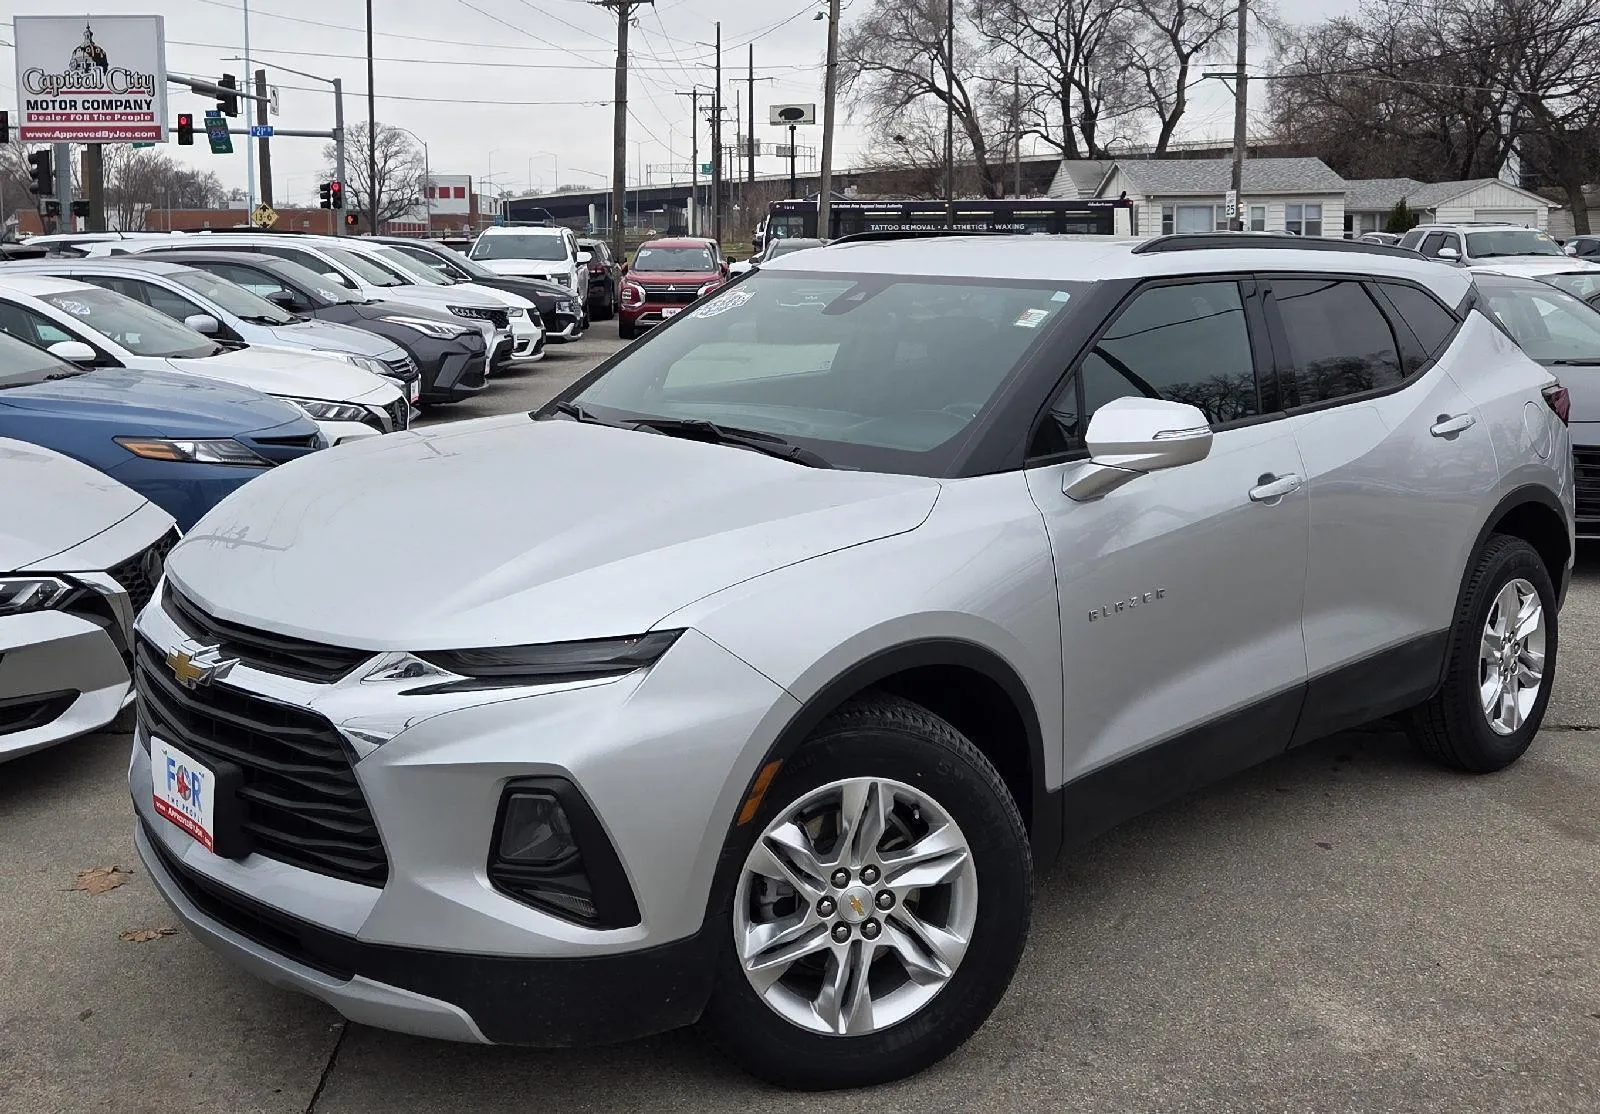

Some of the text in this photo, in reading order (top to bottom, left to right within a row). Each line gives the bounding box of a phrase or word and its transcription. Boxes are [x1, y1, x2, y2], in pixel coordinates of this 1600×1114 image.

[22, 66, 156, 97] Capital City
[26, 99, 153, 111] MOTOR COMPANY
[31, 113, 151, 122] Dealer FOR The People
[25, 130, 156, 139] www.ApprovedByJoe.com
[1226, 204, 1235, 216] 25
[1088, 588, 1165, 622] BLAZER
